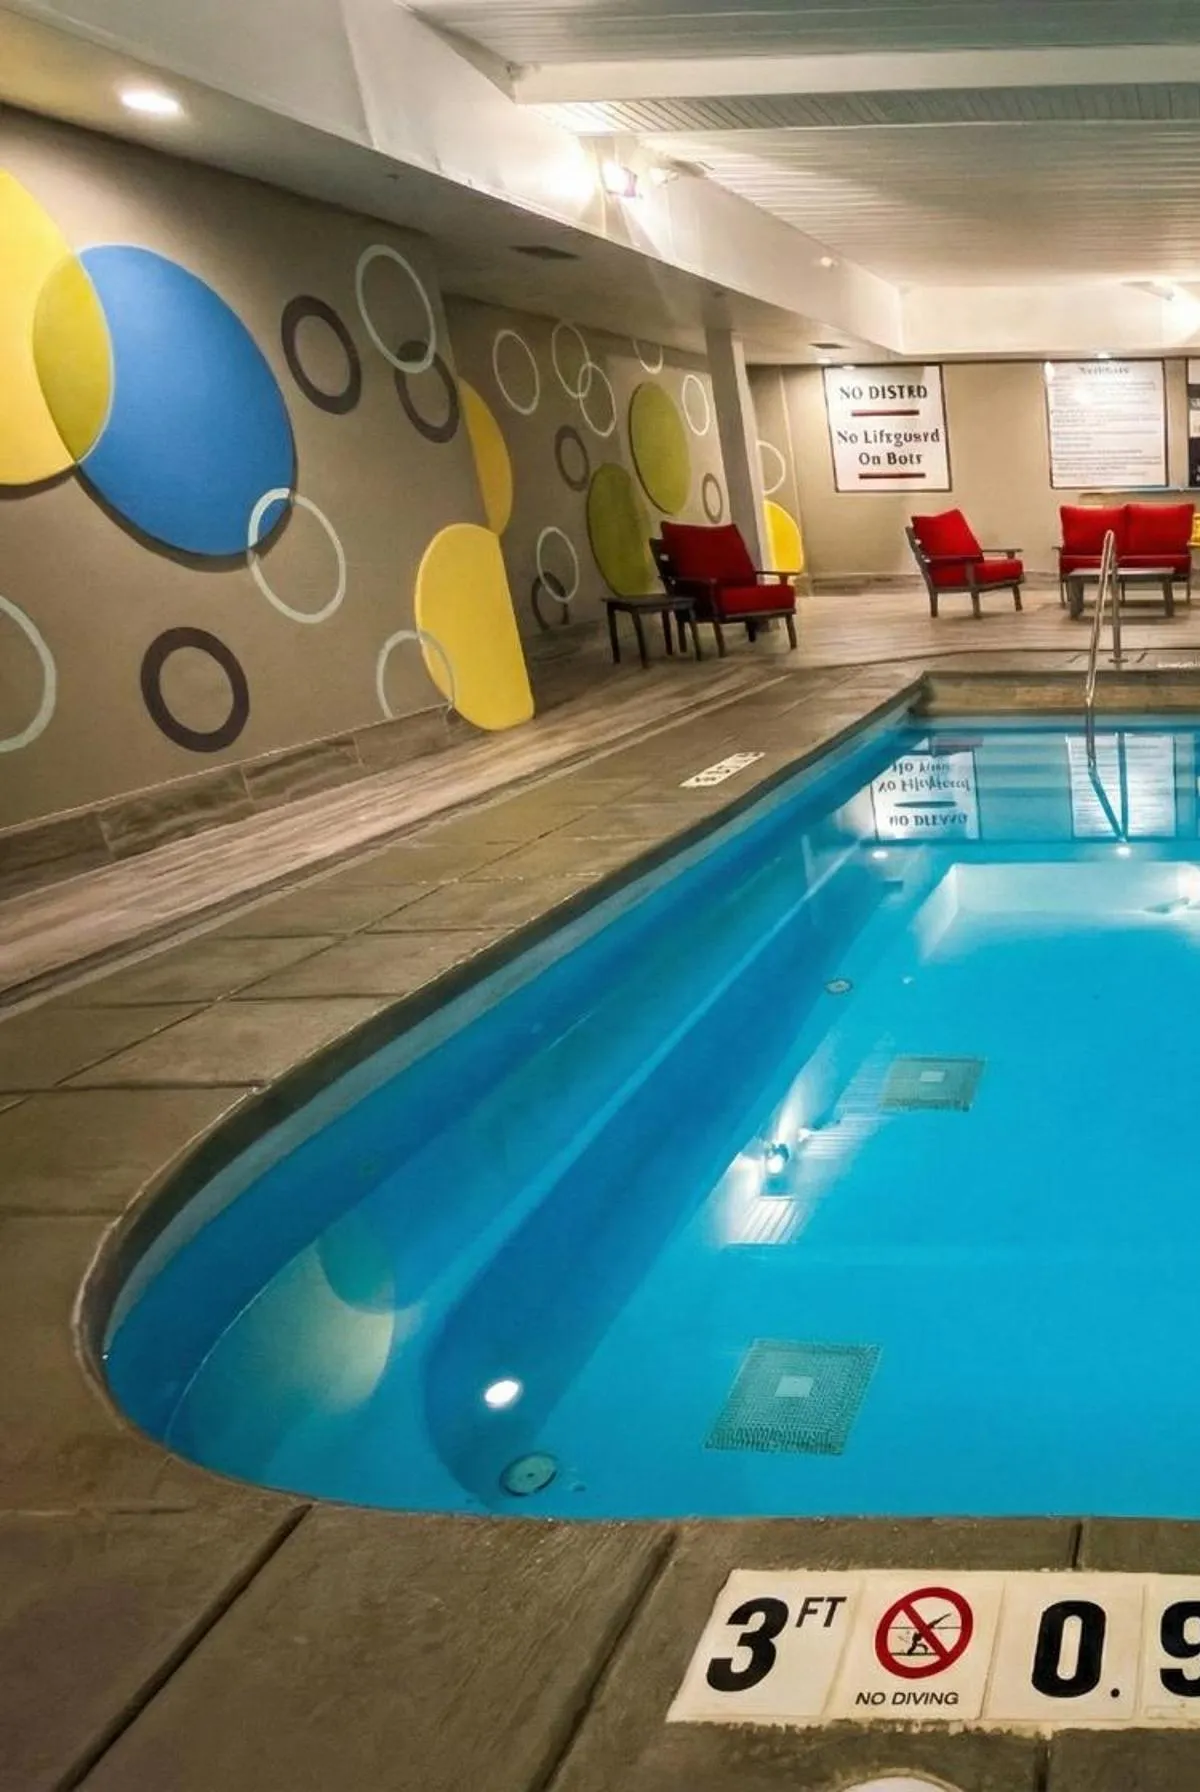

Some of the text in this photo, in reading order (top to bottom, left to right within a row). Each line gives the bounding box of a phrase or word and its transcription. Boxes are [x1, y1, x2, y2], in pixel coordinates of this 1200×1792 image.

[839, 385, 863, 400] NO
[836, 429, 859, 443] No
[858, 452, 882, 465] On
[706, 1596, 847, 1692] 3 FT
[855, 1692, 959, 1705] NO DIVING
